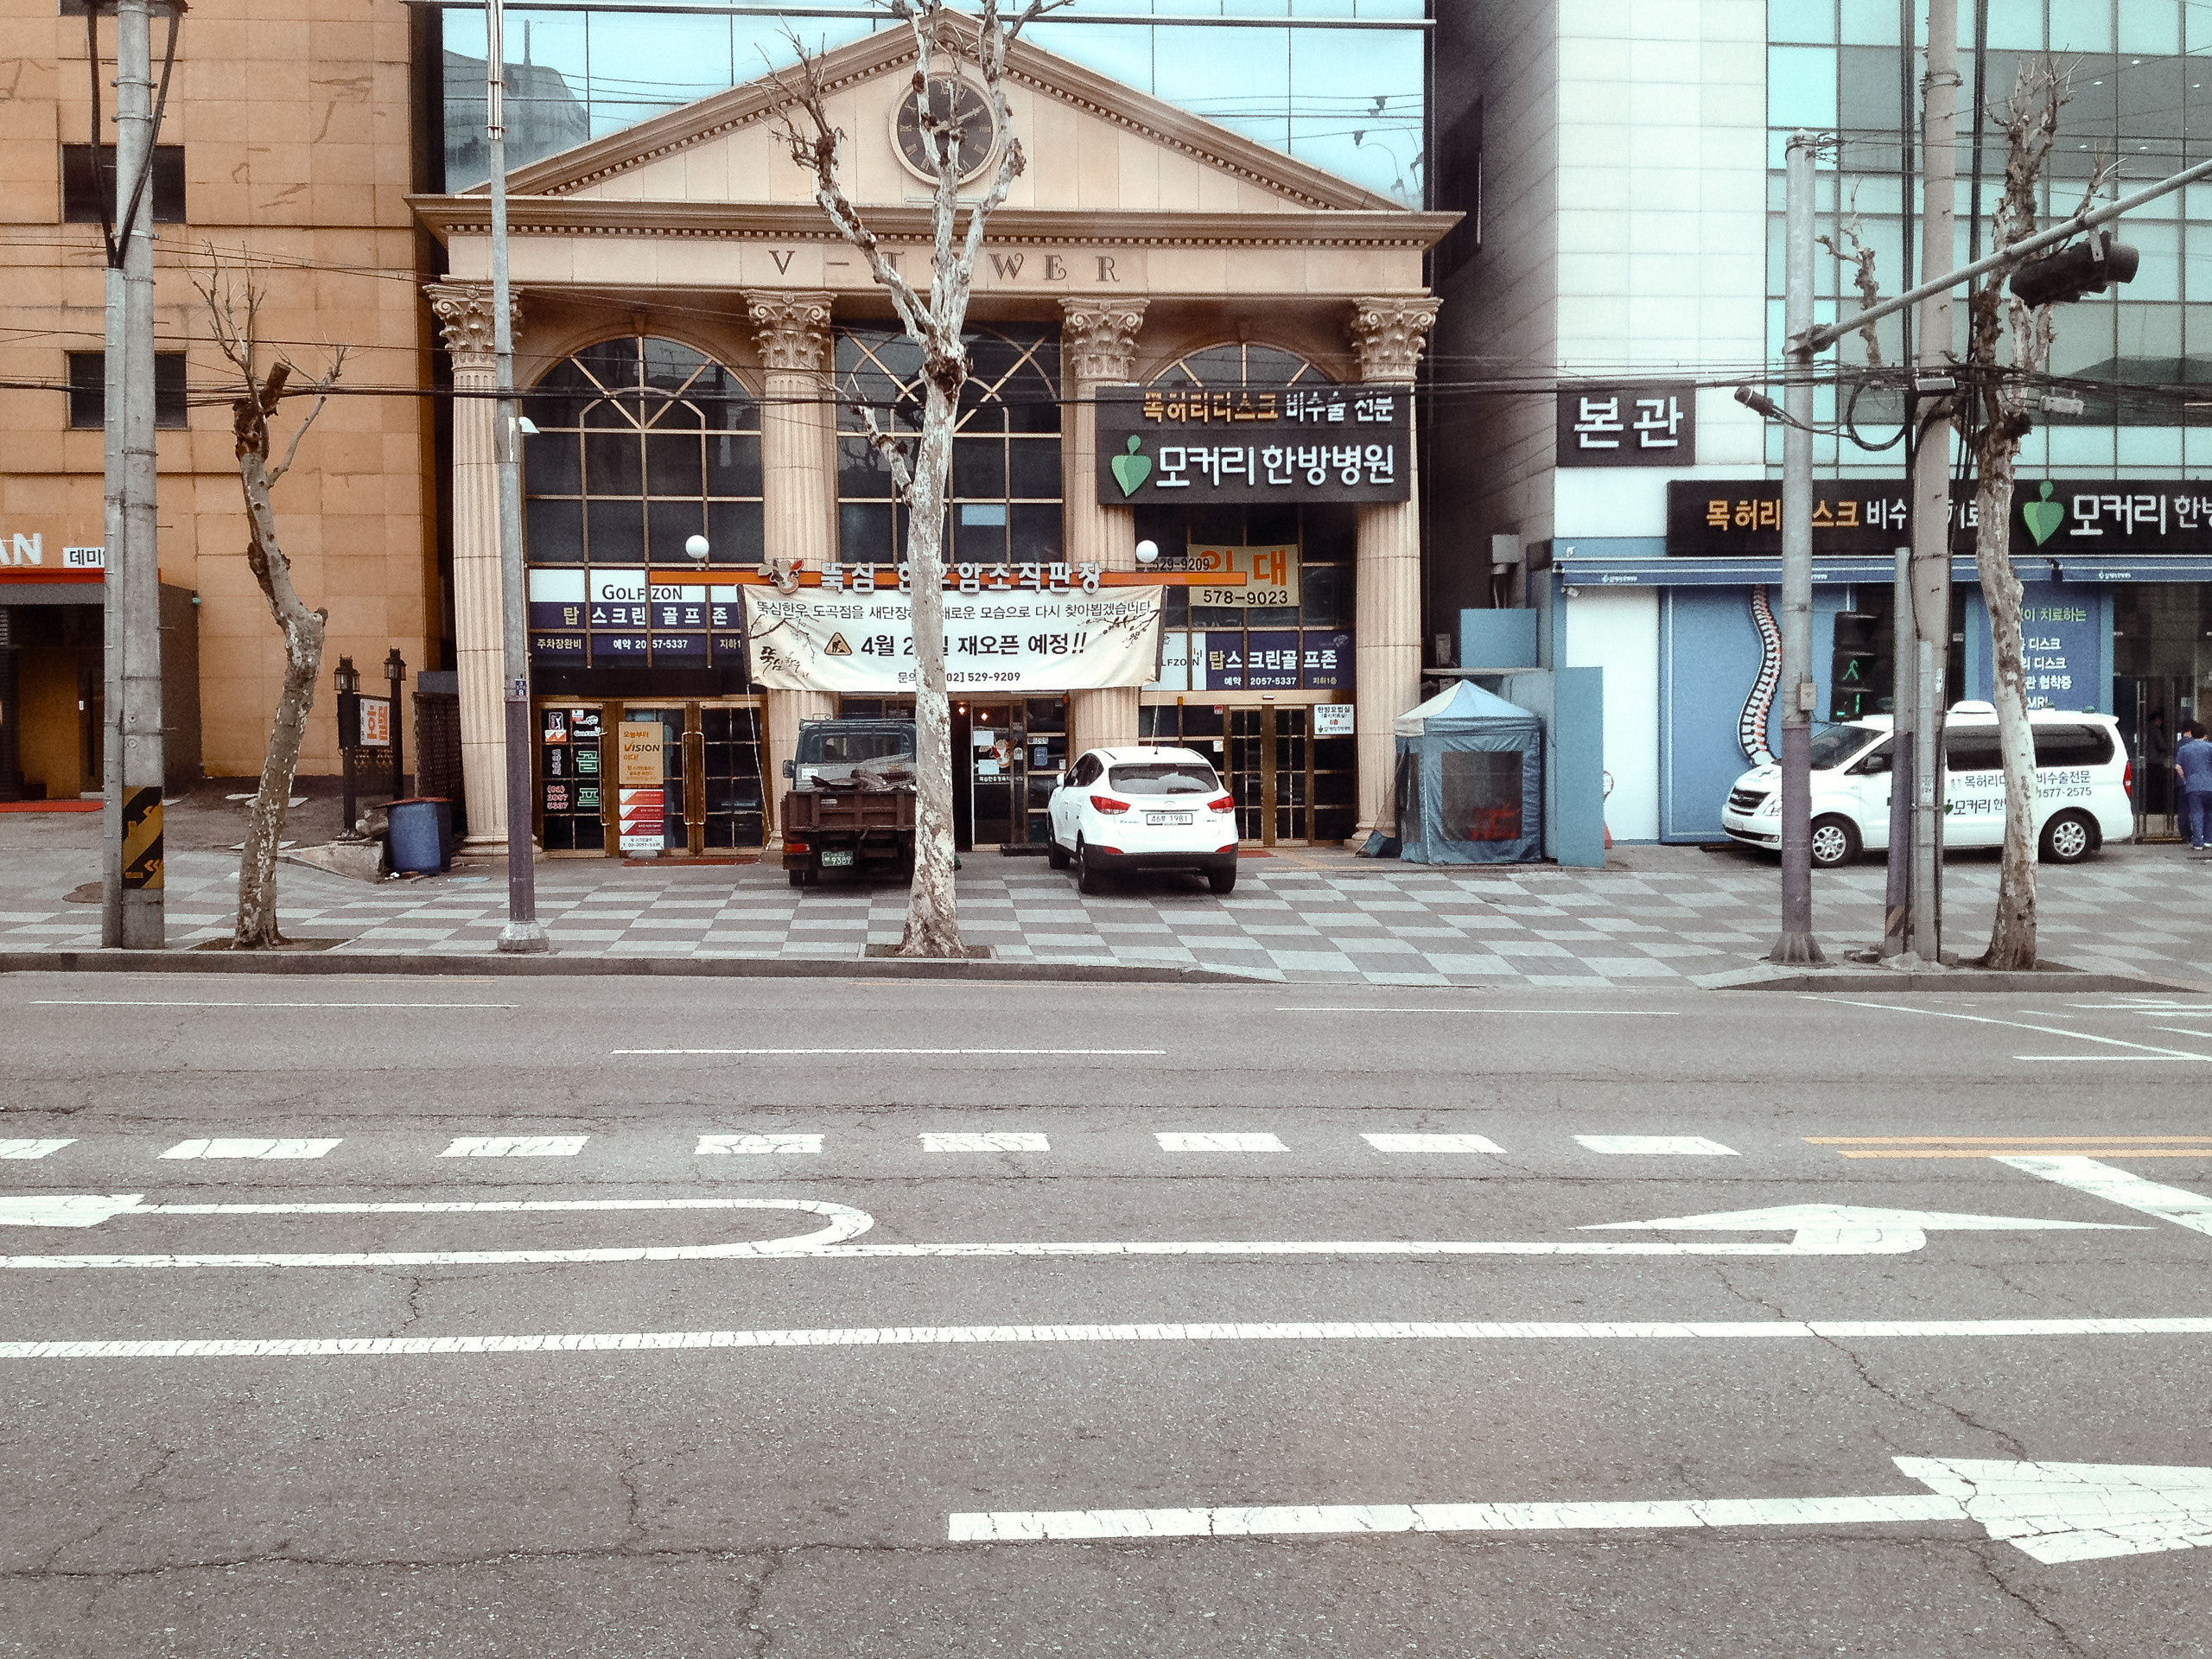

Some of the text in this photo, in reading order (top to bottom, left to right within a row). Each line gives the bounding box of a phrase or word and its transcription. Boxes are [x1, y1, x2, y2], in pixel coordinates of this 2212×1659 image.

[1574, 396, 1684, 448] 본관
[1155, 444, 1395, 487] 모커리 한방병원
[1706, 499, 1859, 531] 목허리스크
[1866, 499, 1907, 530] 비수
[2069, 493, 2166, 536] 모커리
[69, 549, 105, 566] 데미
[821, 562, 875, 594] 뚝심
[1203, 589, 1288, 605] 578-9023
[563, 607, 580, 626] 탑
[755, 601, 809, 617] 뚝심한우
[812, 605, 865, 620] 도곡점을
[868, 606, 912, 620] 새단장
[980, 606, 1031, 620] 모습으로
[1035, 605, 1060, 619] 다시
[2041, 607, 2087, 622] 치료하는
[613, 639, 632, 650] 예약
[861, 635, 895, 657] 4월
[957, 634, 1020, 657] 재오픈
[1027, 632, 1088, 655] 예정!!
[2029, 637, 2063, 652] 디스크
[2034, 656, 2068, 671] 디스크
[968, 671, 1021, 682] 529-9209
[1224, 677, 1242, 686] 예약
[2039, 675, 2073, 690] 협착증
[624, 741, 661, 753] VISION
[1953, 798, 2006, 816] 모커리 한
